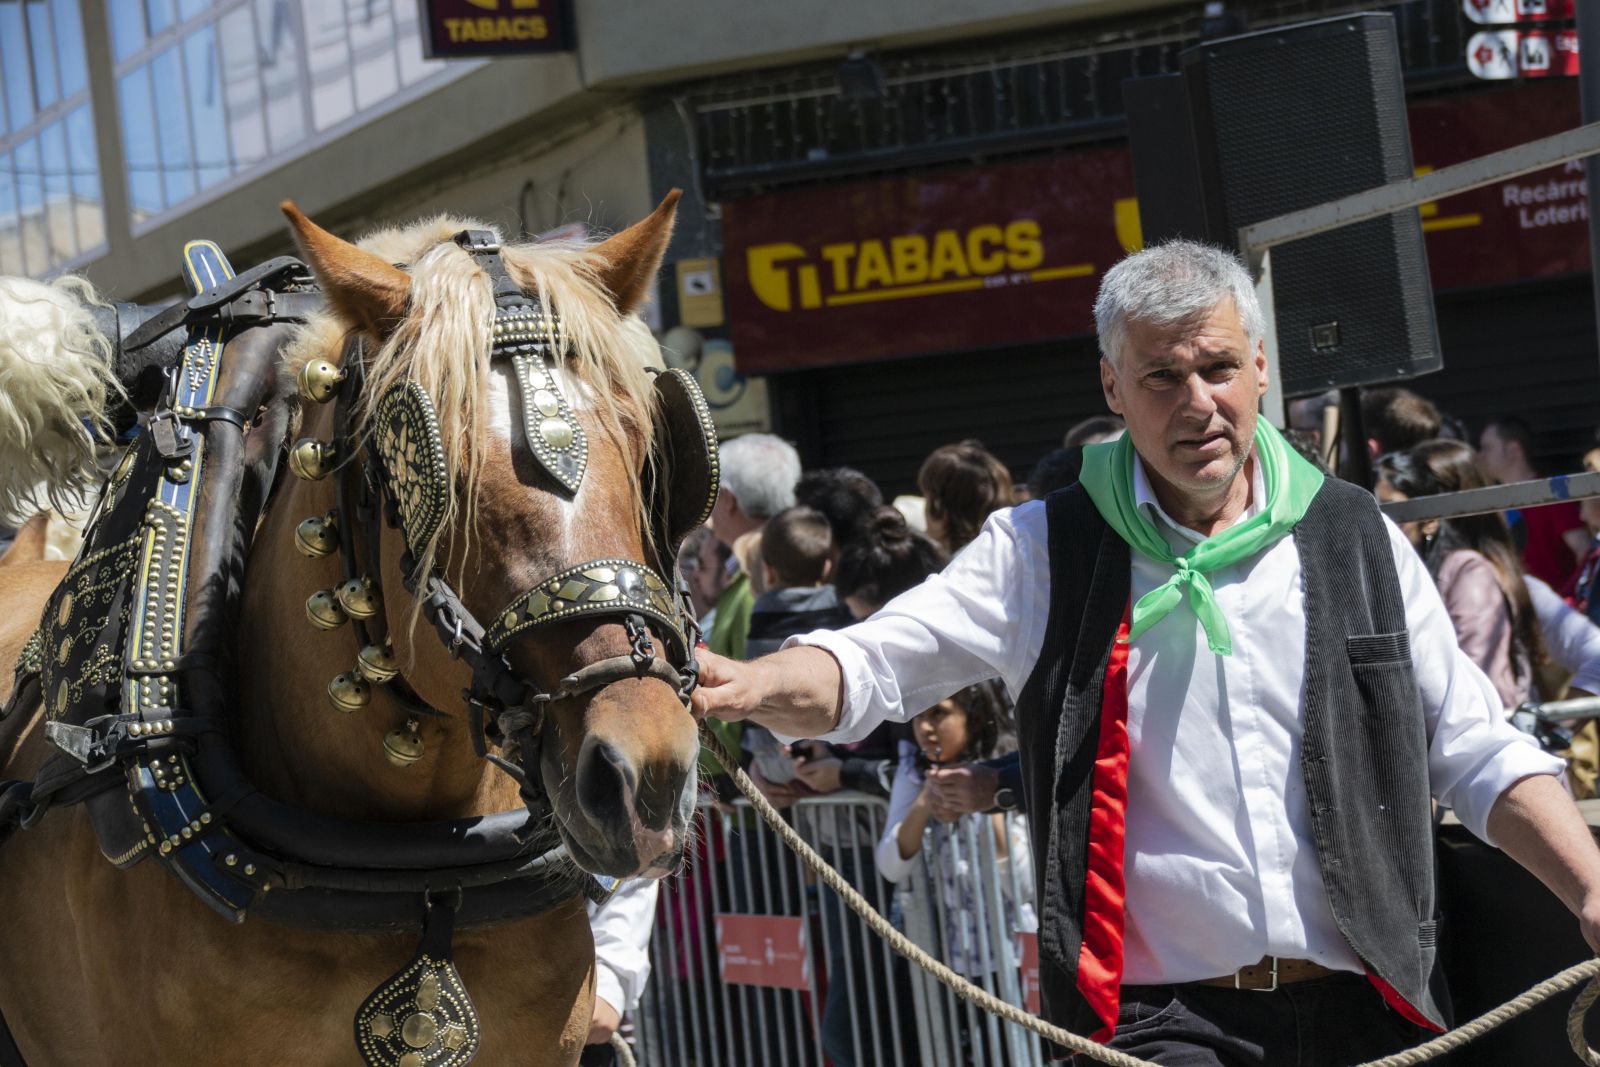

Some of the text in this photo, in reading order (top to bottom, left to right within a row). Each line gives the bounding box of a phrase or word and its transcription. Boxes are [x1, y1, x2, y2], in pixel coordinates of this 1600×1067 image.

[444, 15, 548, 43] TABACS
[1519, 200, 1589, 229] Loteri
[821, 219, 1046, 293] TABACS
